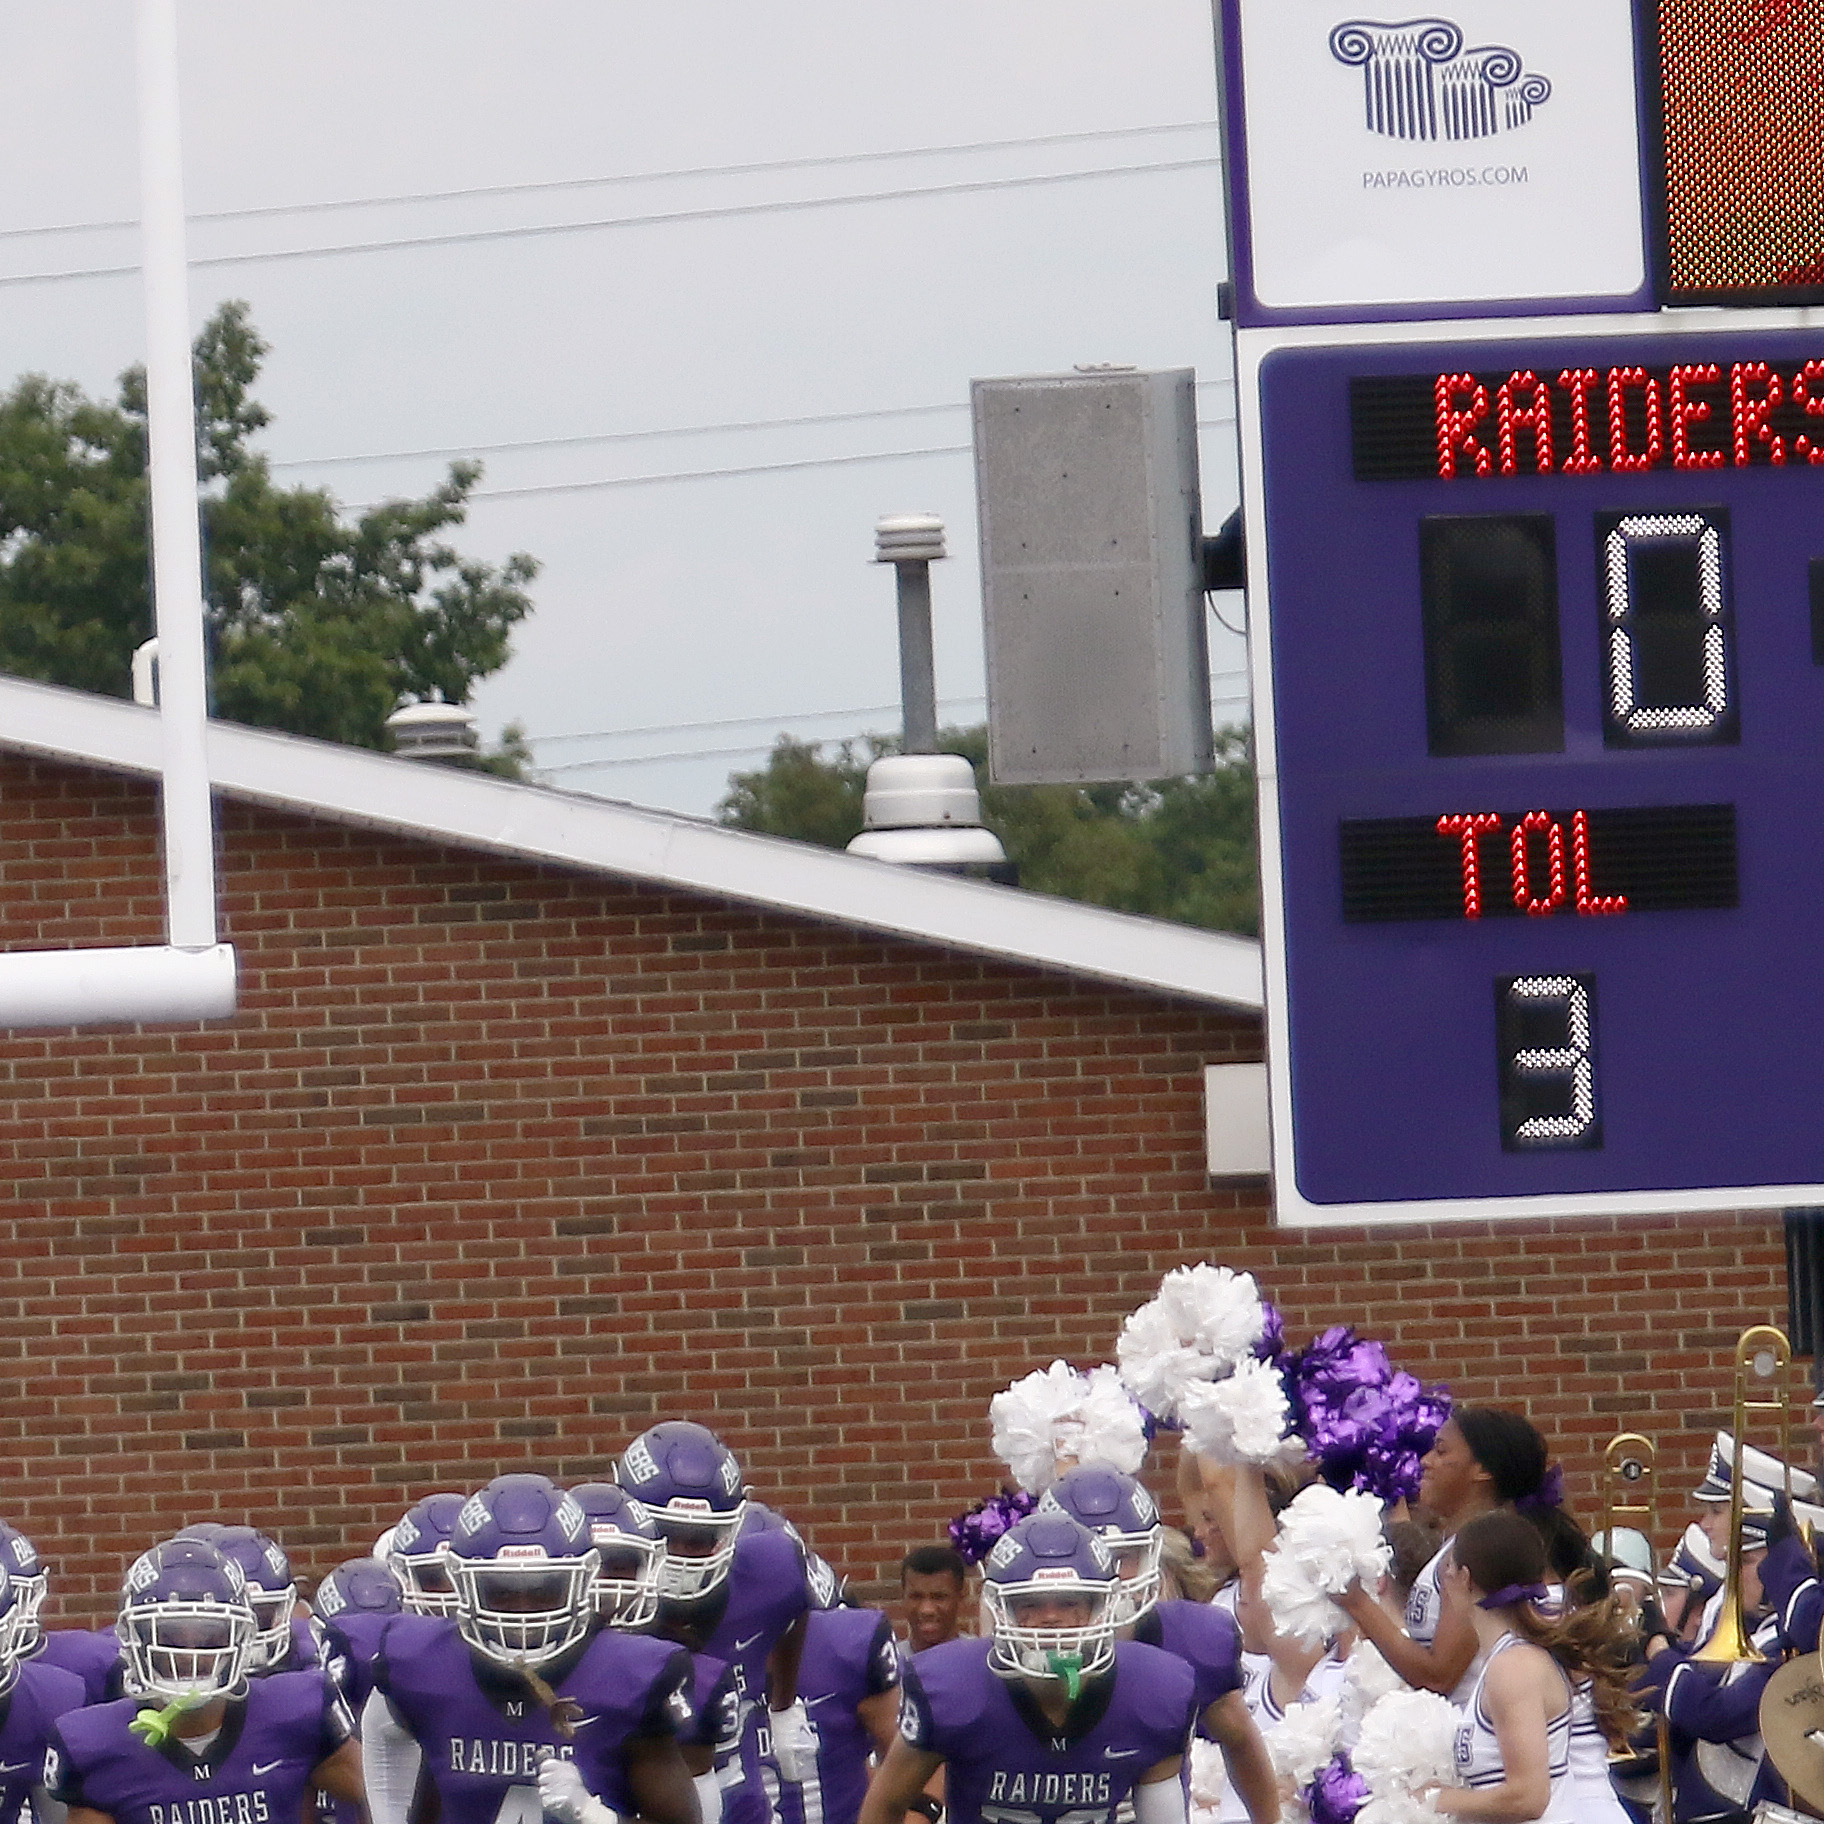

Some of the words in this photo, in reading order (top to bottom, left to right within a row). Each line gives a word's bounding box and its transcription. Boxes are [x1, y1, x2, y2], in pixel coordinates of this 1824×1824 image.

[1363, 166, 1529, 188] PAPAGYROS.COM
[1434, 360, 1824, 480] RAIDERS
[1605, 513, 1726, 730] 0
[1435, 809, 1629, 919] TOL
[1510, 974, 1595, 1137] 3
[506, 1702, 523, 1718] M
[194, 1764, 211, 1780] M
[989, 1770, 1111, 1804] RAIDERS
